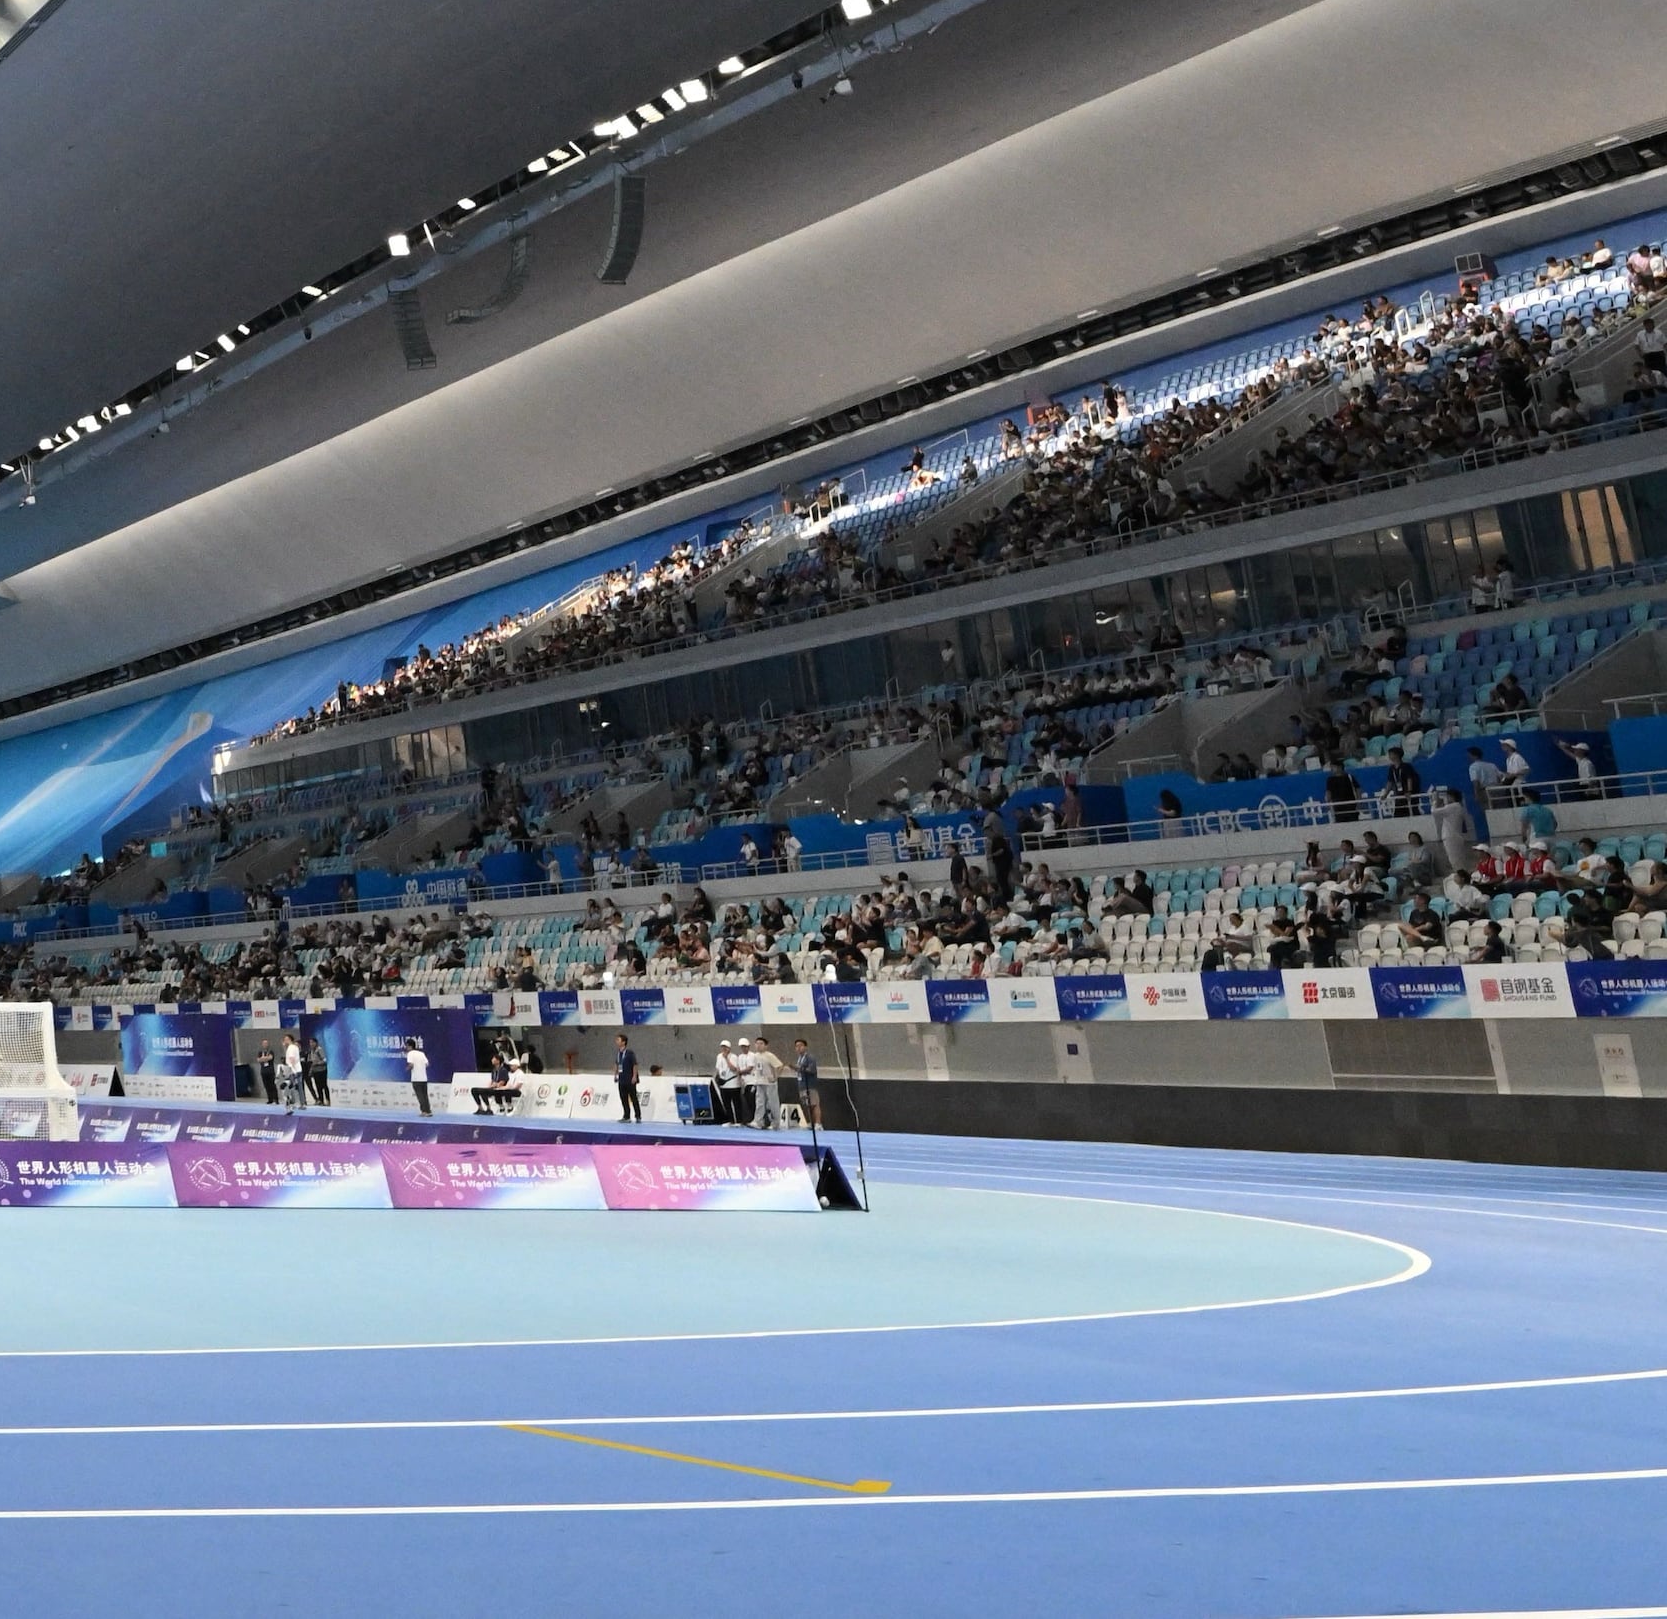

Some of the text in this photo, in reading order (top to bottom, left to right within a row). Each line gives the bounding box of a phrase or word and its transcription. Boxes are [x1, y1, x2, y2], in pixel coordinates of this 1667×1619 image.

[1321, 985, 1356, 1000] 北京国资
[1500, 977, 1556, 995] 首钢基金
[1503, 994, 1557, 1002] SHOUGANG FUND
[790, 1108, 801, 1123] 4
[17, 1161, 156, 1176] 世界人形机器人运动会
[233, 1162, 371, 1176] 世界人形机器人运动会
[447, 1163, 584, 1179] 世界人形机器人运动会
[660, 1165, 796, 1181] 世界人形机器人运动会
[20, 1177, 37, 1186] The
[38, 1177, 62, 1186] World
[236, 1179, 252, 1187] The
[253, 1179, 278, 1187] World
[450, 1179, 465, 1188] The
[466, 1180, 492, 1188] World
[664, 1182, 679, 1190] The
[681, 1182, 706, 1190] World
